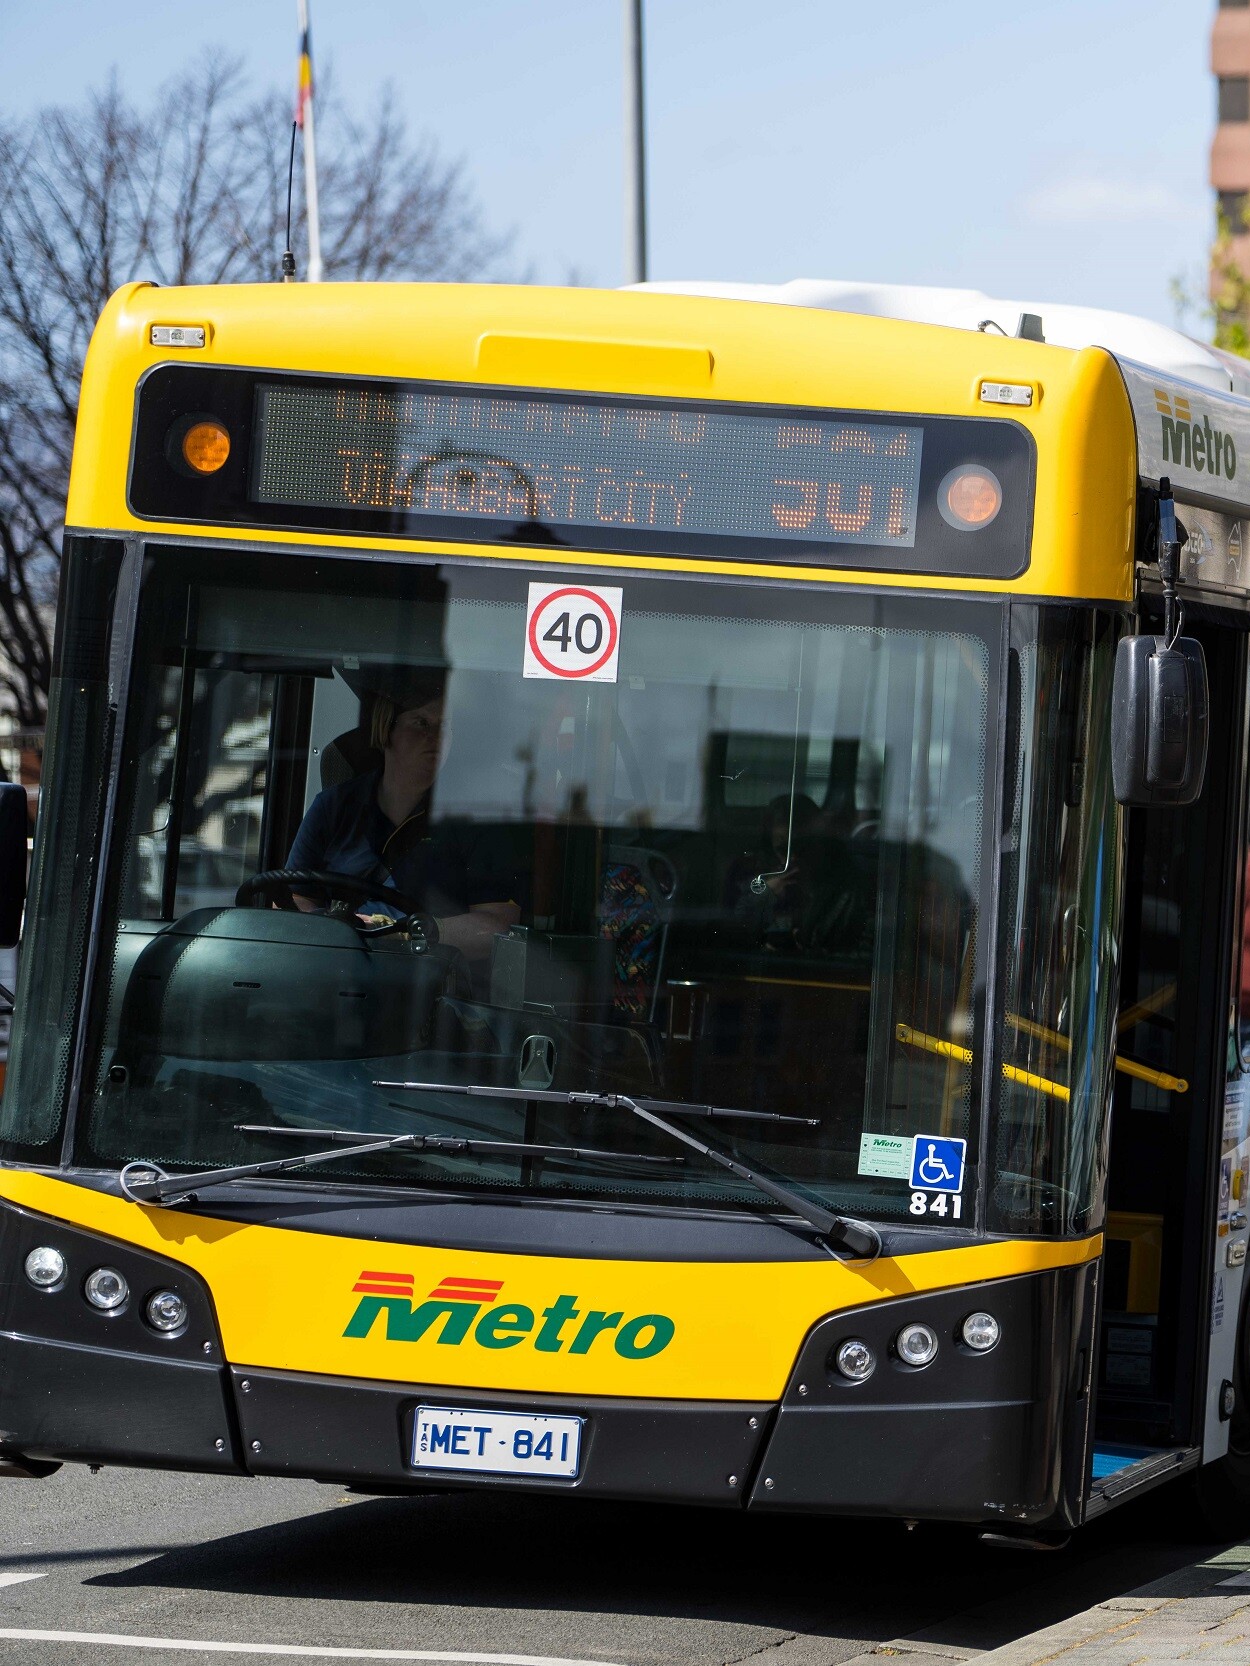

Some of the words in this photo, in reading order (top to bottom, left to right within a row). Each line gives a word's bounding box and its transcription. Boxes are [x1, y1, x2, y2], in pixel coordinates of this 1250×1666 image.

[1154, 388, 1237, 481] Metro
[542, 611, 603, 655] 40
[873, 1138, 902, 1148] Metro
[909, 1191, 962, 1219] 841
[342, 1270, 676, 1360] Metro
[420, 1423, 430, 1452] TAS
